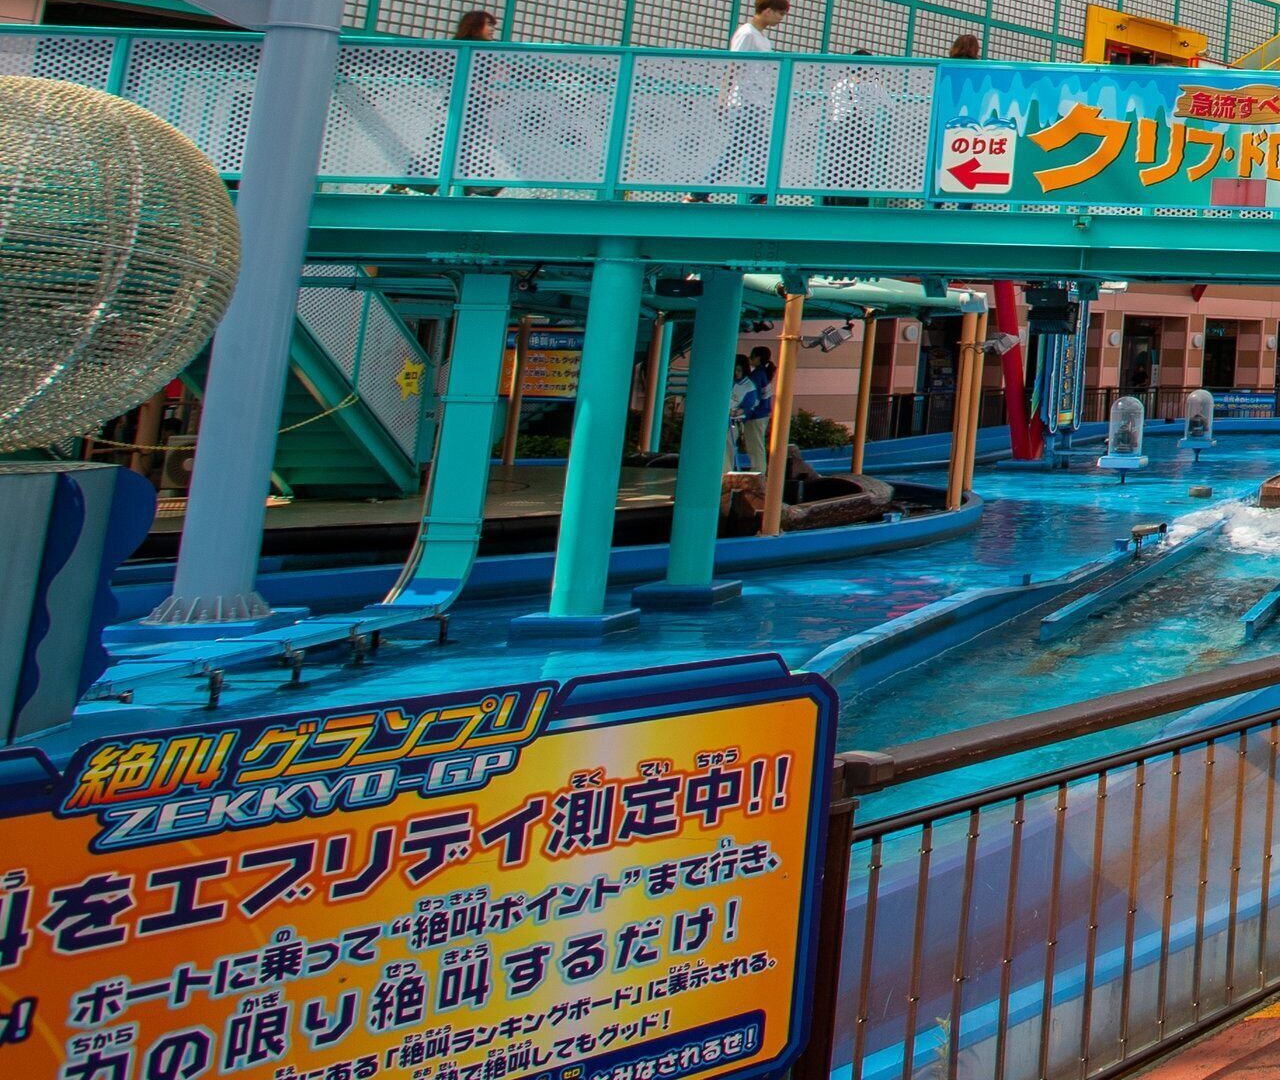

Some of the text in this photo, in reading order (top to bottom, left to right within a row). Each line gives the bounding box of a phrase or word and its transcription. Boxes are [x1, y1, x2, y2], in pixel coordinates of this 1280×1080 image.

[950, 137, 1007, 156] のりば
[696, 748, 739, 769] ちゅう
[640, 760, 671, 778] てい
[571, 770, 604, 789] そく
[99, 750, 518, 846] ZEKKYO-GP
[448, 887, 489, 904] きょう
[275, 928, 292, 943] の
[443, 942, 489, 965] きょう
[241, 990, 281, 1013] かぎ
[72, 1025, 135, 1054] ちから
